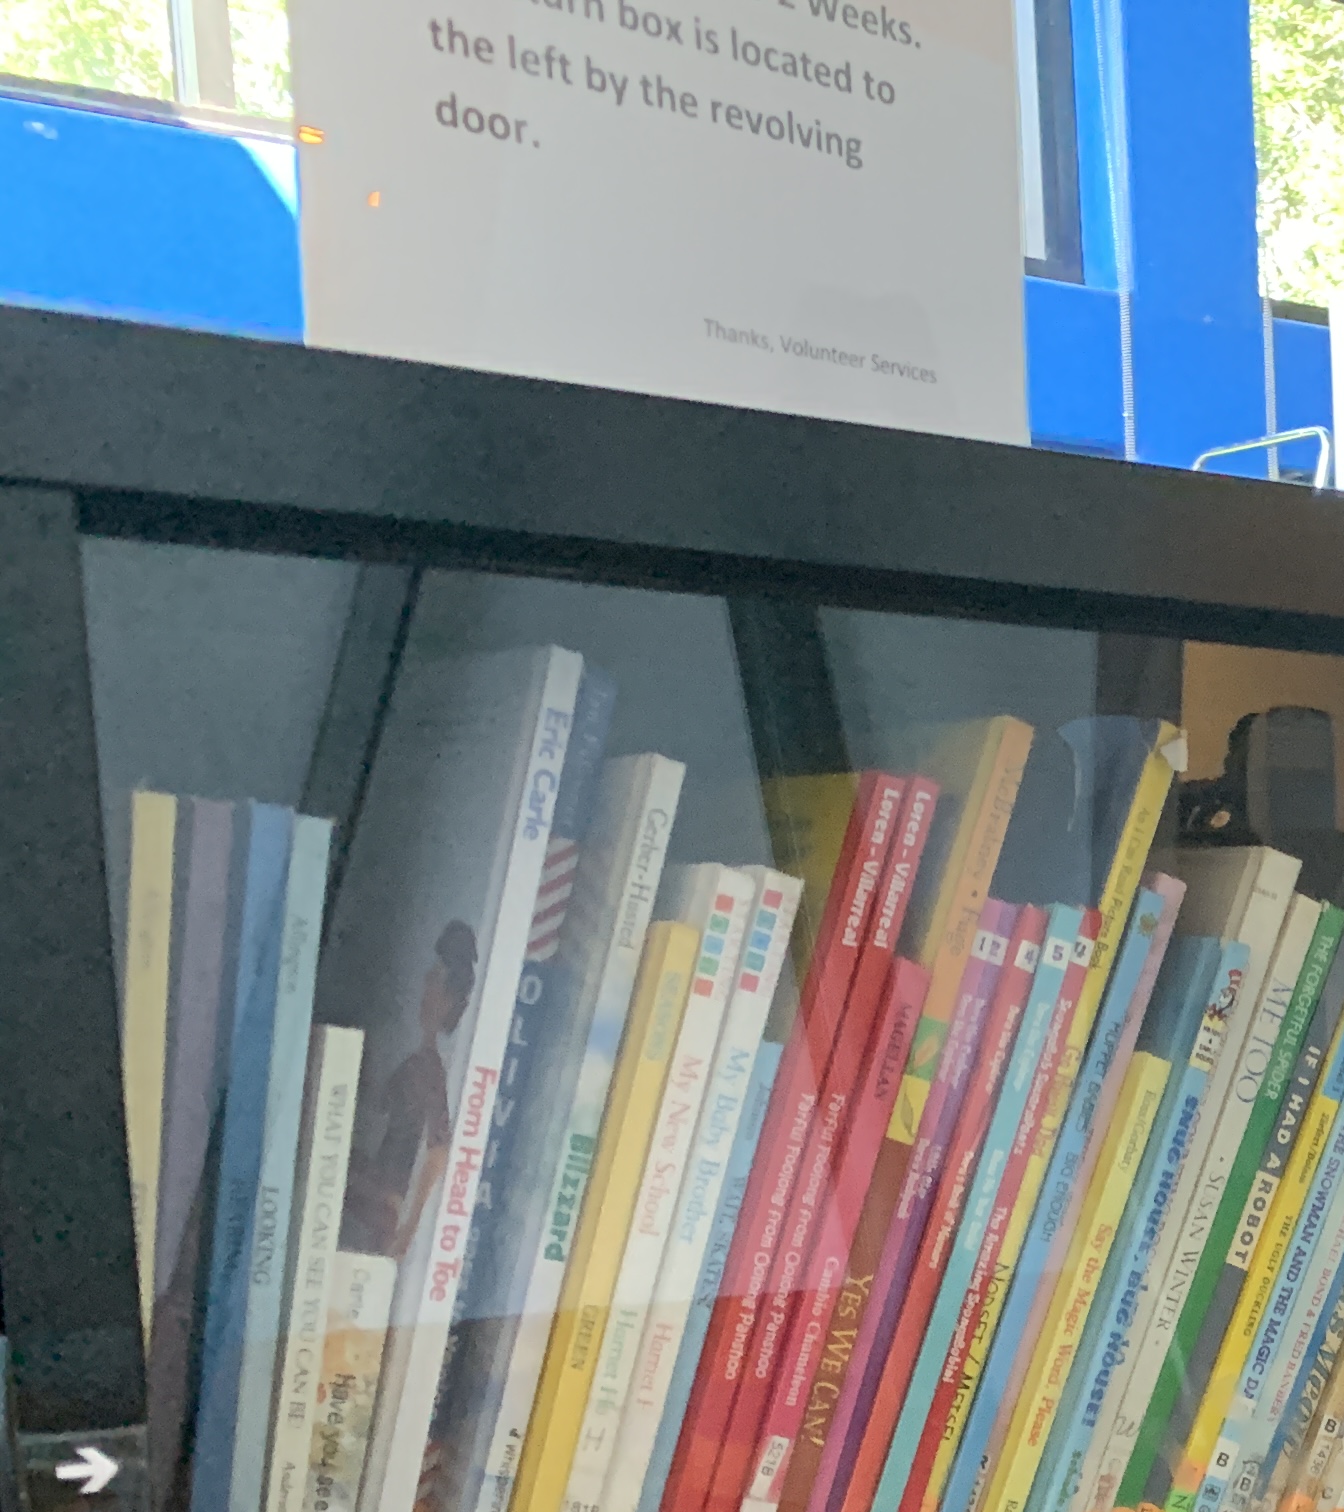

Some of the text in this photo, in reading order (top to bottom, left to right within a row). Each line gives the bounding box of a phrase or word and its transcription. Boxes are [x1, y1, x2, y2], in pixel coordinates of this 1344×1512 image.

[617, 0, 682, 46] box
[694, 17, 719, 56] is
[731, 26, 851, 94] located
[864, 69, 896, 105] to
[809, 0, 921, 49] Weeks.
[428, 18, 864, 170] the left by the revolving
[435, 91, 541, 149] door.
[704, 318, 937, 384] Thanks, Volunteer Services
[521, 706, 570, 843] Eric Carle
[841, 786, 902, 948] Loren Villarreal
[873, 789, 934, 949] Loren Villarreal
[1262, 935, 1335, 1100] THE FORGETFUL SPIDER
[312, 1154, 339, 1252] YOU CAN
[429, 1065, 498, 1302] From Head to Toe
[543, 1132, 596, 1262] Blizzard
[638, 1160, 677, 1238] School
[1231, 1092, 1305, 1269] HAD ROBOT
[1300, 1155, 1341, 1243] SNOWMAN
[1153, 1171, 1226, 1330] SUSAN WINTER
[1273, 1285, 1294, 1314] THE
[1285, 1248, 1308, 1285] AND
[819, 1273, 875, 1375] YES WE
[1027, 1222, 1113, 1448] Say the Magic Please
[1243, 1276, 1272, 1338] DUCKLING
[1252, 1319, 1282, 1377] MAGIC
